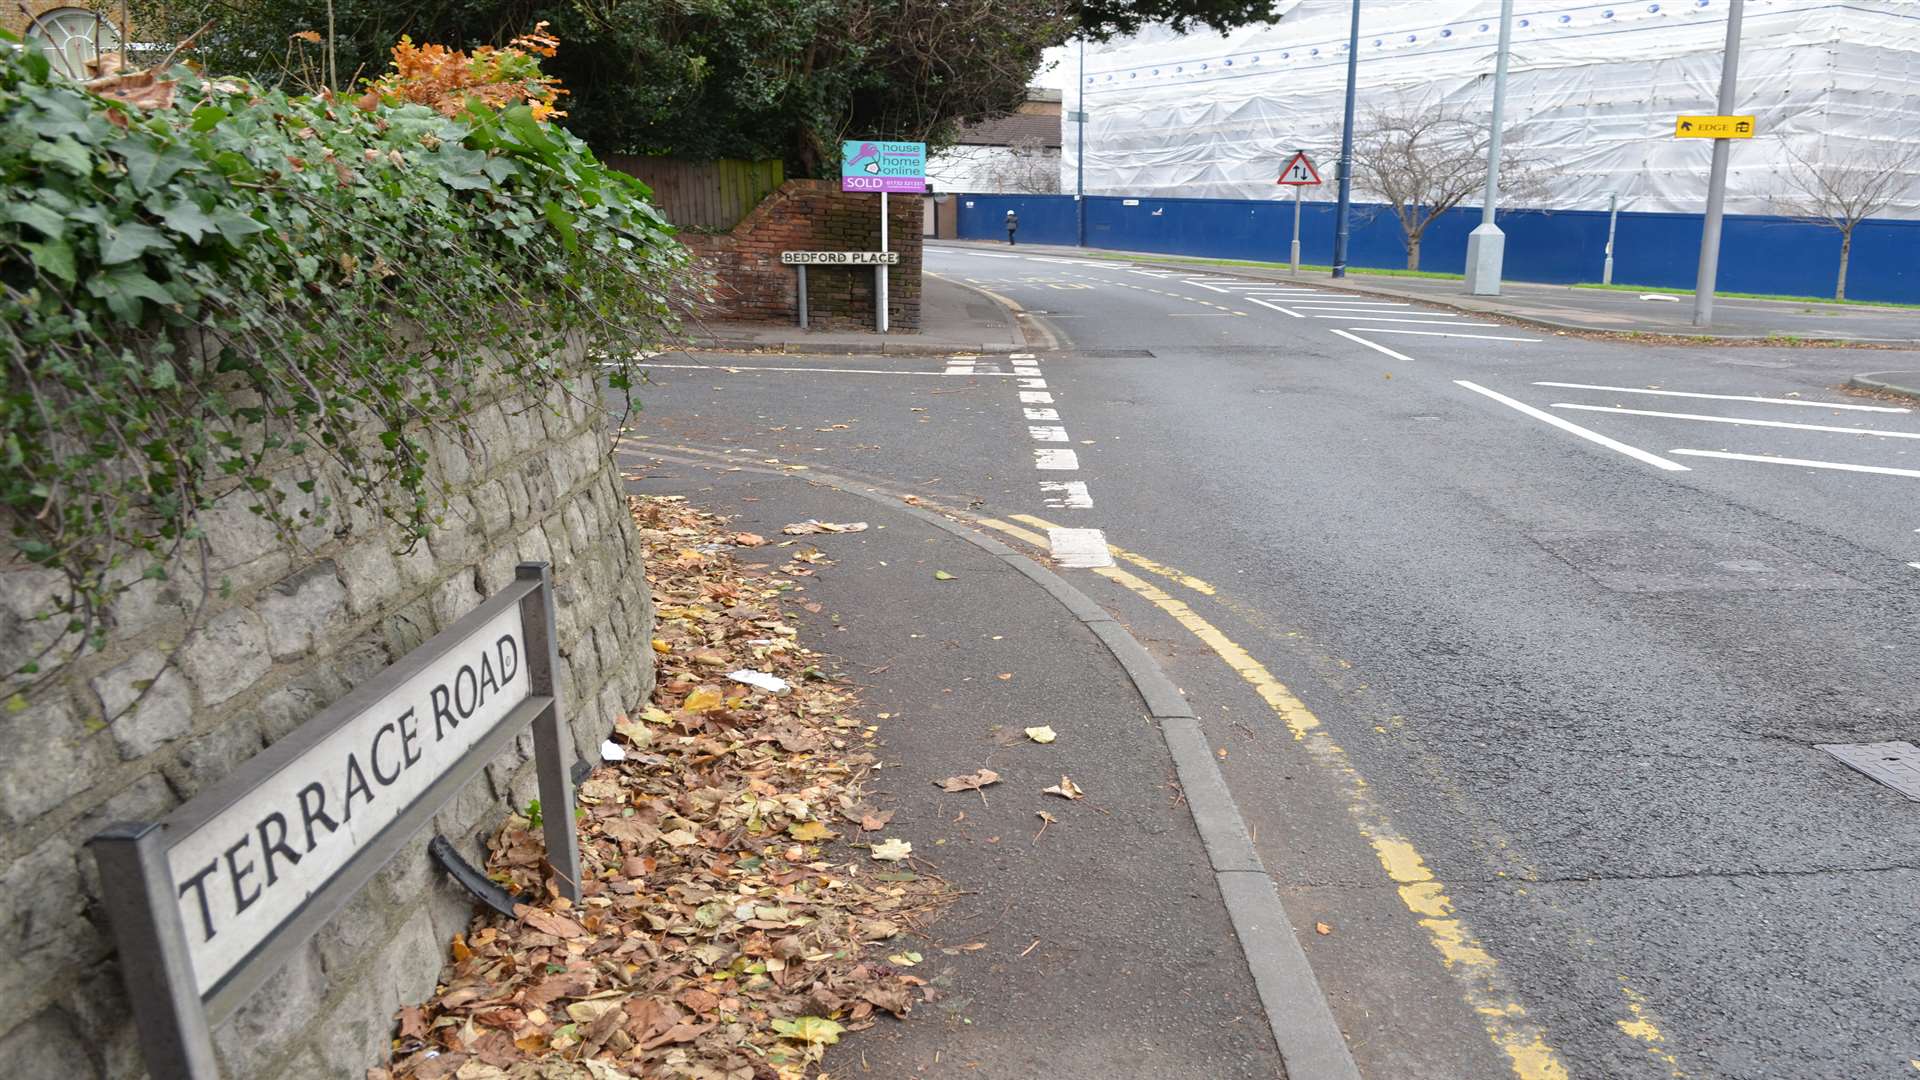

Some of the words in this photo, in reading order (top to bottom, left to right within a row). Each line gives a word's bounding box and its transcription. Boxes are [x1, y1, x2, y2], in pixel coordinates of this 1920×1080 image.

[1698, 123, 1729, 131] EDGE
[883, 144, 920, 152] house
[883, 157, 920, 166] home
[883, 166, 920, 175] online
[847, 178, 883, 188] SOLD
[784, 253, 847, 263] BEDFORD
[852, 253, 896, 263] PLACE
[178, 706, 422, 944] TERRACE
[431, 633, 518, 741] ROAD
